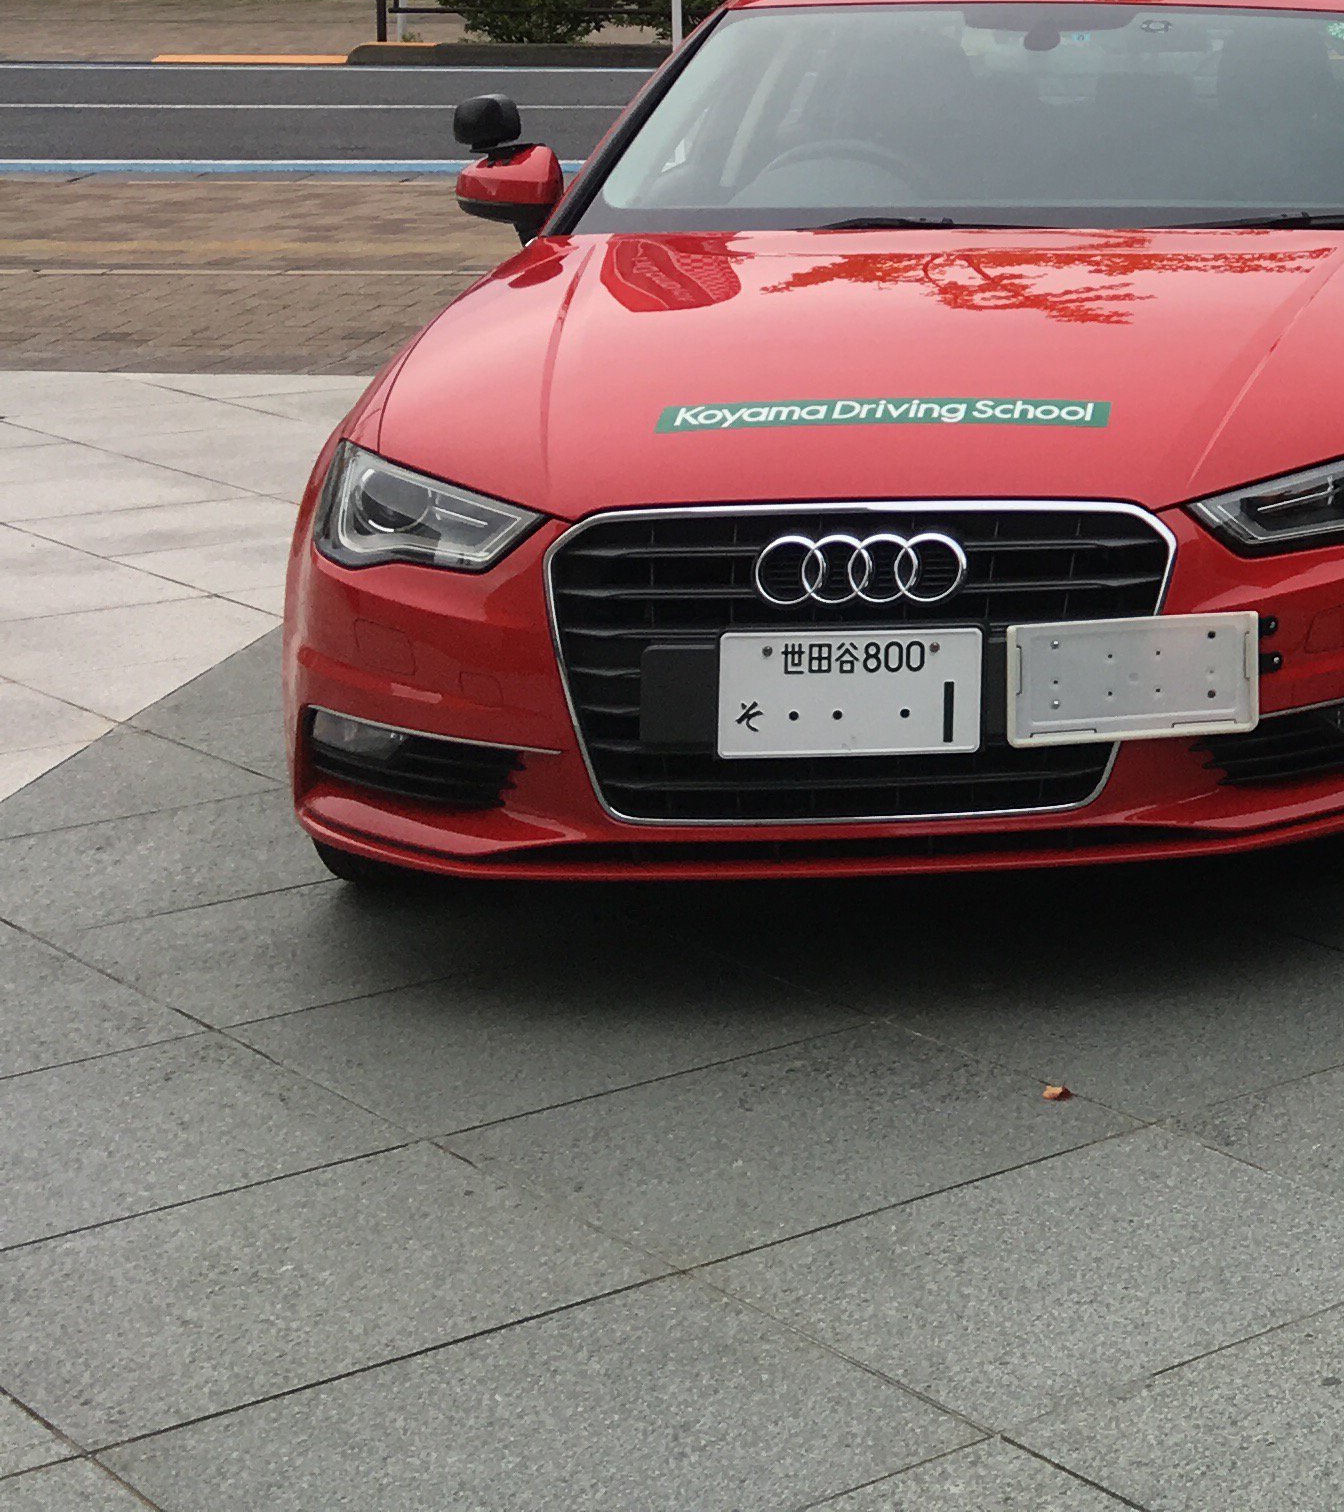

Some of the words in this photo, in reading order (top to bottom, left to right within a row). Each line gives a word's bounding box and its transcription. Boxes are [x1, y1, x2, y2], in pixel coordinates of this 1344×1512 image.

[673, 401, 827, 428] Koyama
[831, 399, 965, 423] Driving
[972, 399, 1095, 422] School
[781, 640, 926, 675] 世田谷800
